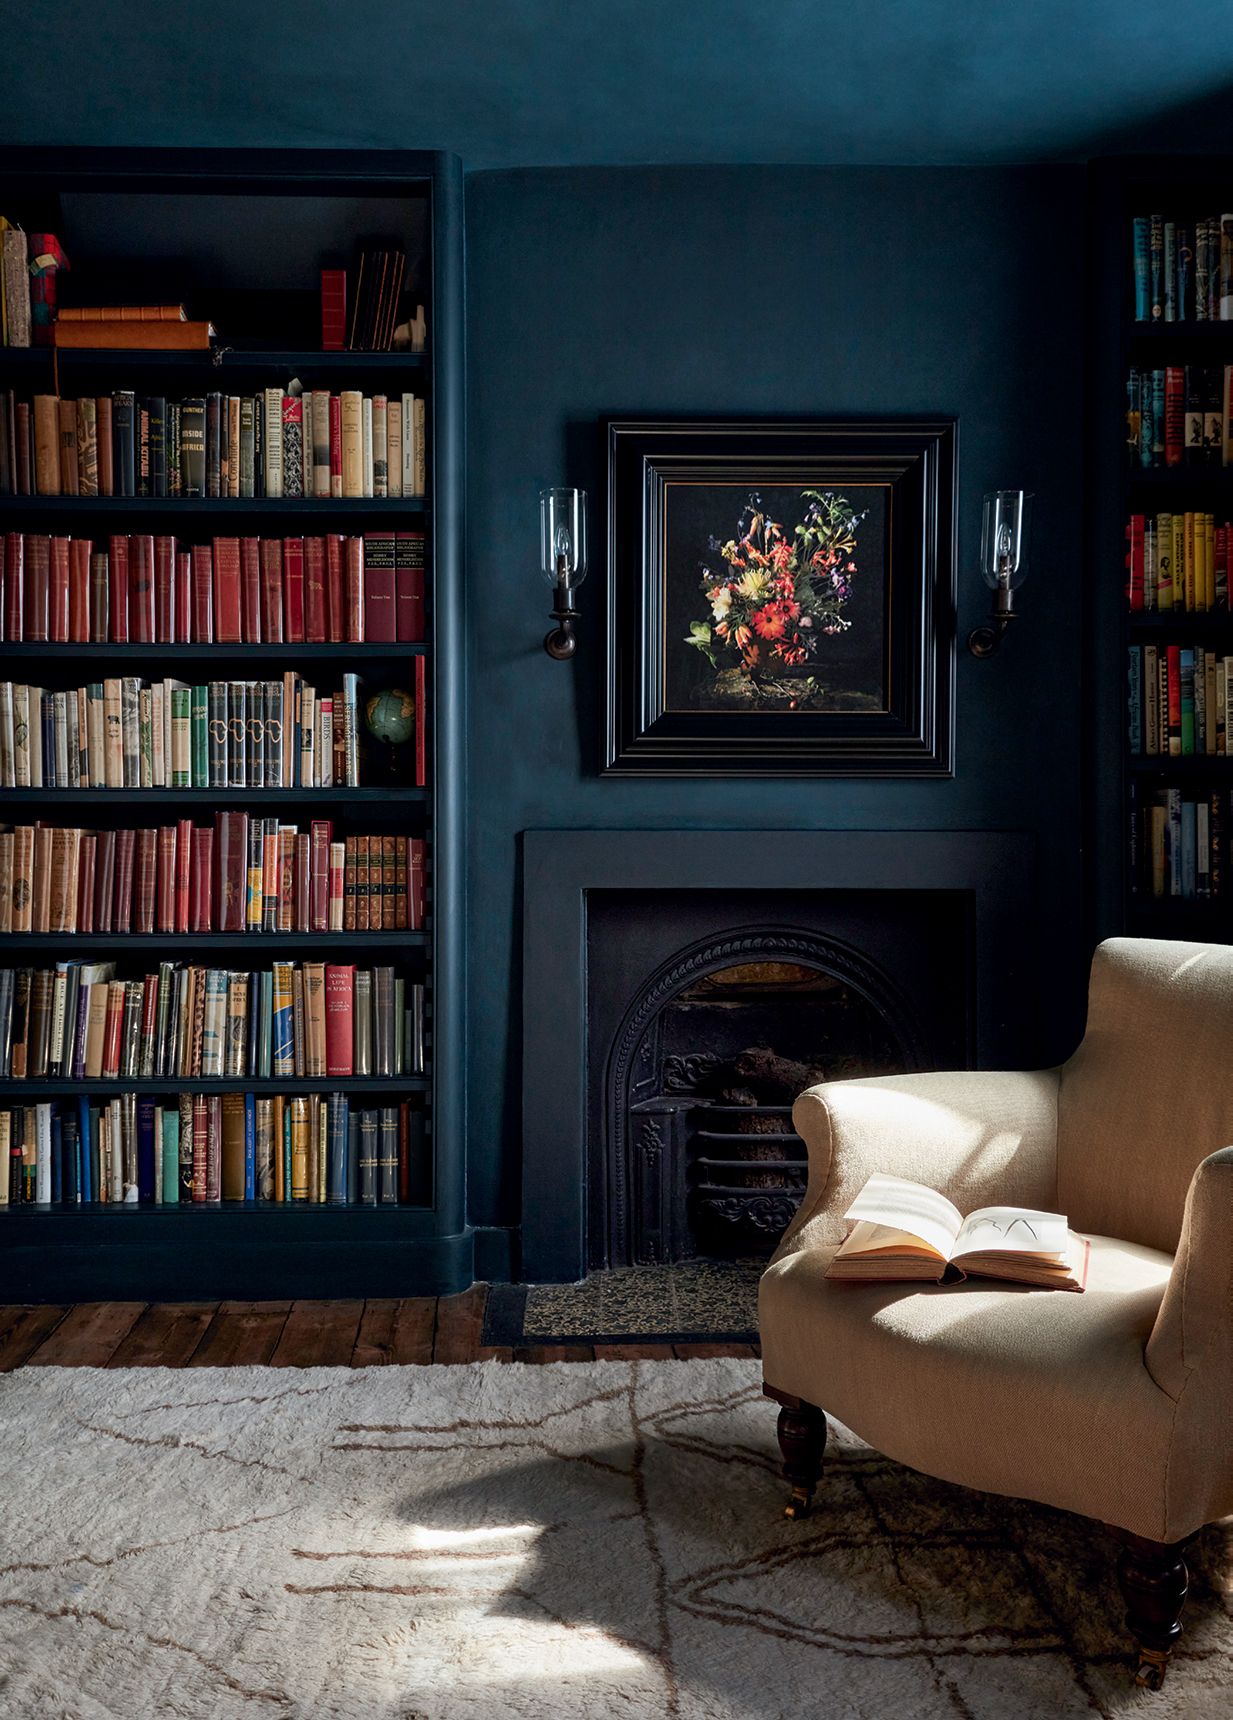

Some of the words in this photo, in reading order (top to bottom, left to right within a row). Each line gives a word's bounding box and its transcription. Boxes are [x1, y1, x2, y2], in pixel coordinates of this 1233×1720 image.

[141, 410, 149, 445] ANIMAL
[182, 430, 203, 438] INSIDE
[182, 443, 204, 451] AFRICA
[323, 716, 331, 740] BIRDS
